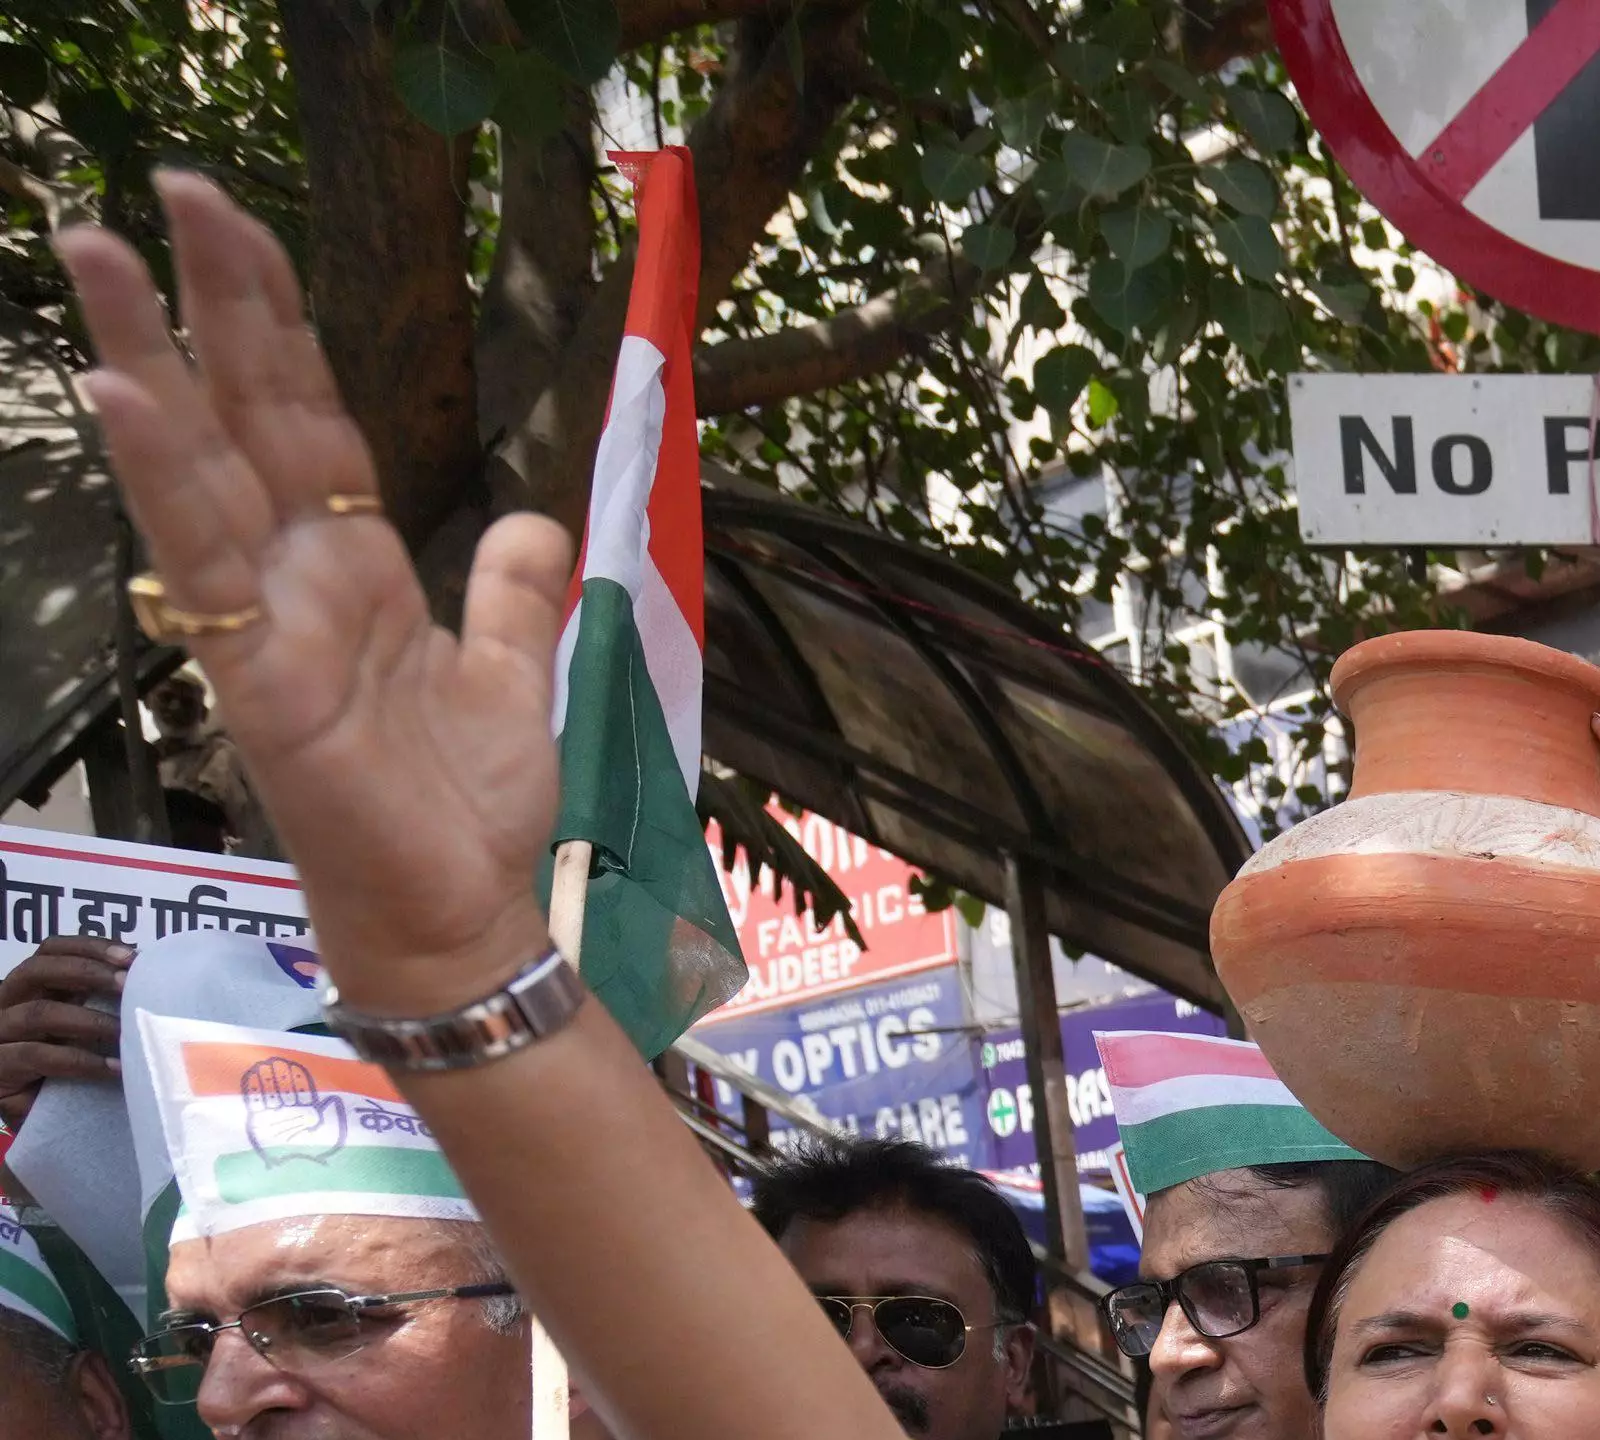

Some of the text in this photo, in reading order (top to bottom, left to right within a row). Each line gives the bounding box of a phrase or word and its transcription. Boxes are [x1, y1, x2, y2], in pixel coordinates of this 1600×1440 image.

[1339, 415, 1493, 496] No
[772, 1006, 942, 1092] OPTICS
[875, 1093, 969, 1148] CARE
